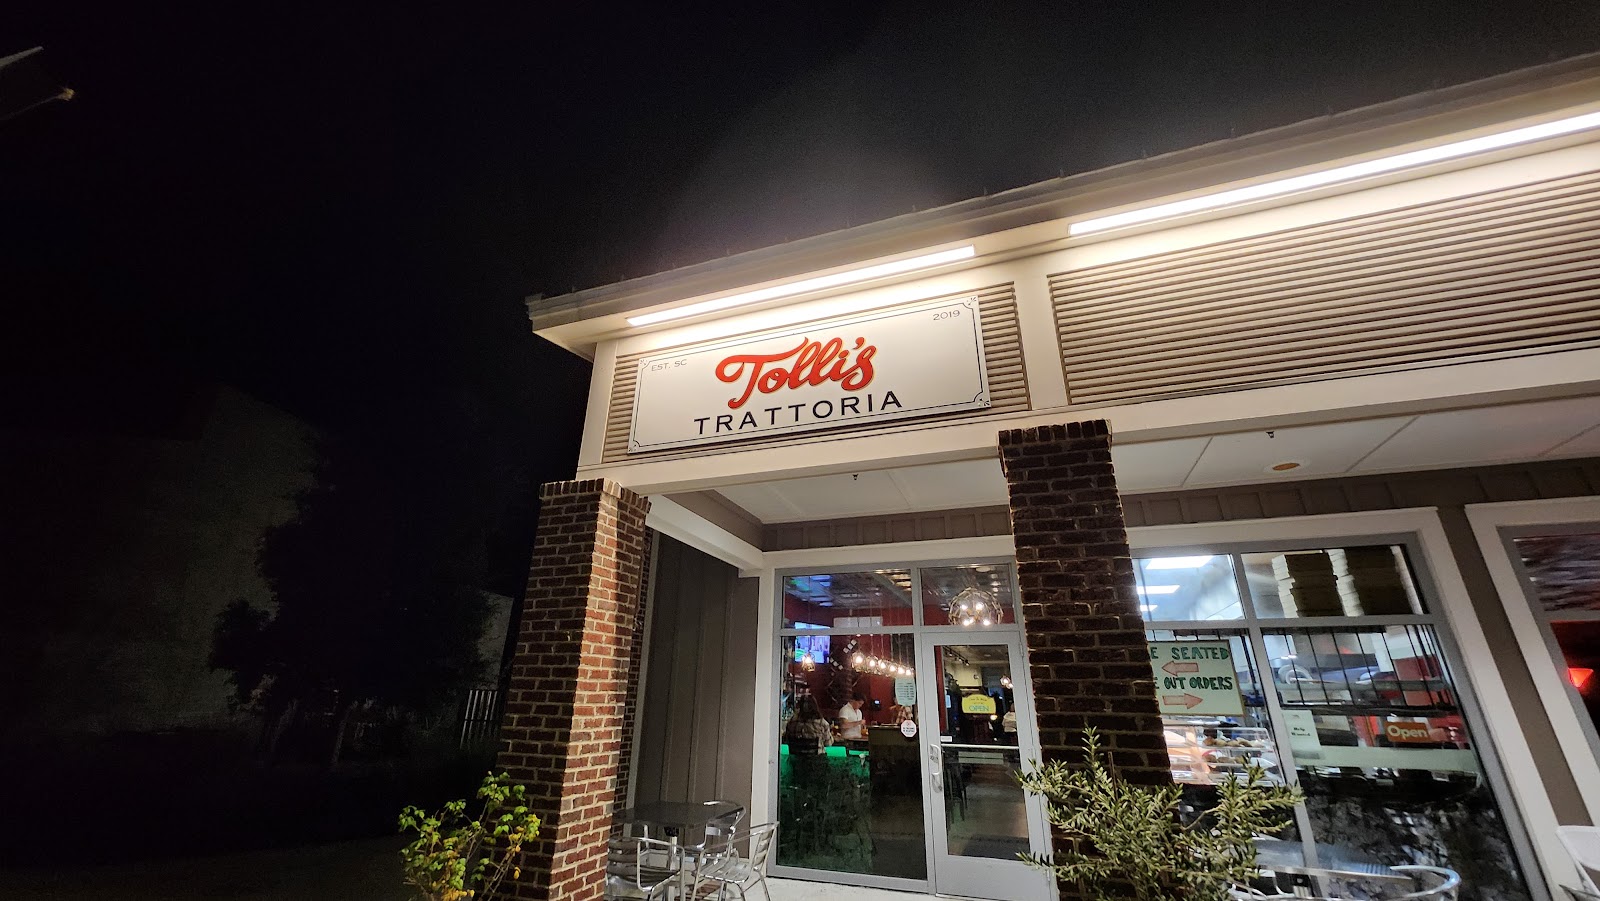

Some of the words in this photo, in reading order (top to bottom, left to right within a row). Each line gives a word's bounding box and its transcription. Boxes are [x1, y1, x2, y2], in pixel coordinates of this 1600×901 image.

[932, 309, 961, 321] 2019
[651, 362, 671, 372] EST.
[674, 358, 688, 368] SC
[714, 336, 878, 410] Tolli's
[693, 390, 903, 436] TRATTORIA
[1171, 646, 1229, 660] SEATED
[1163, 676, 1187, 690] OUT
[1189, 676, 1233, 691] ORDERS
[968, 704, 990, 712] OPEN
[1387, 724, 1428, 741] Open
